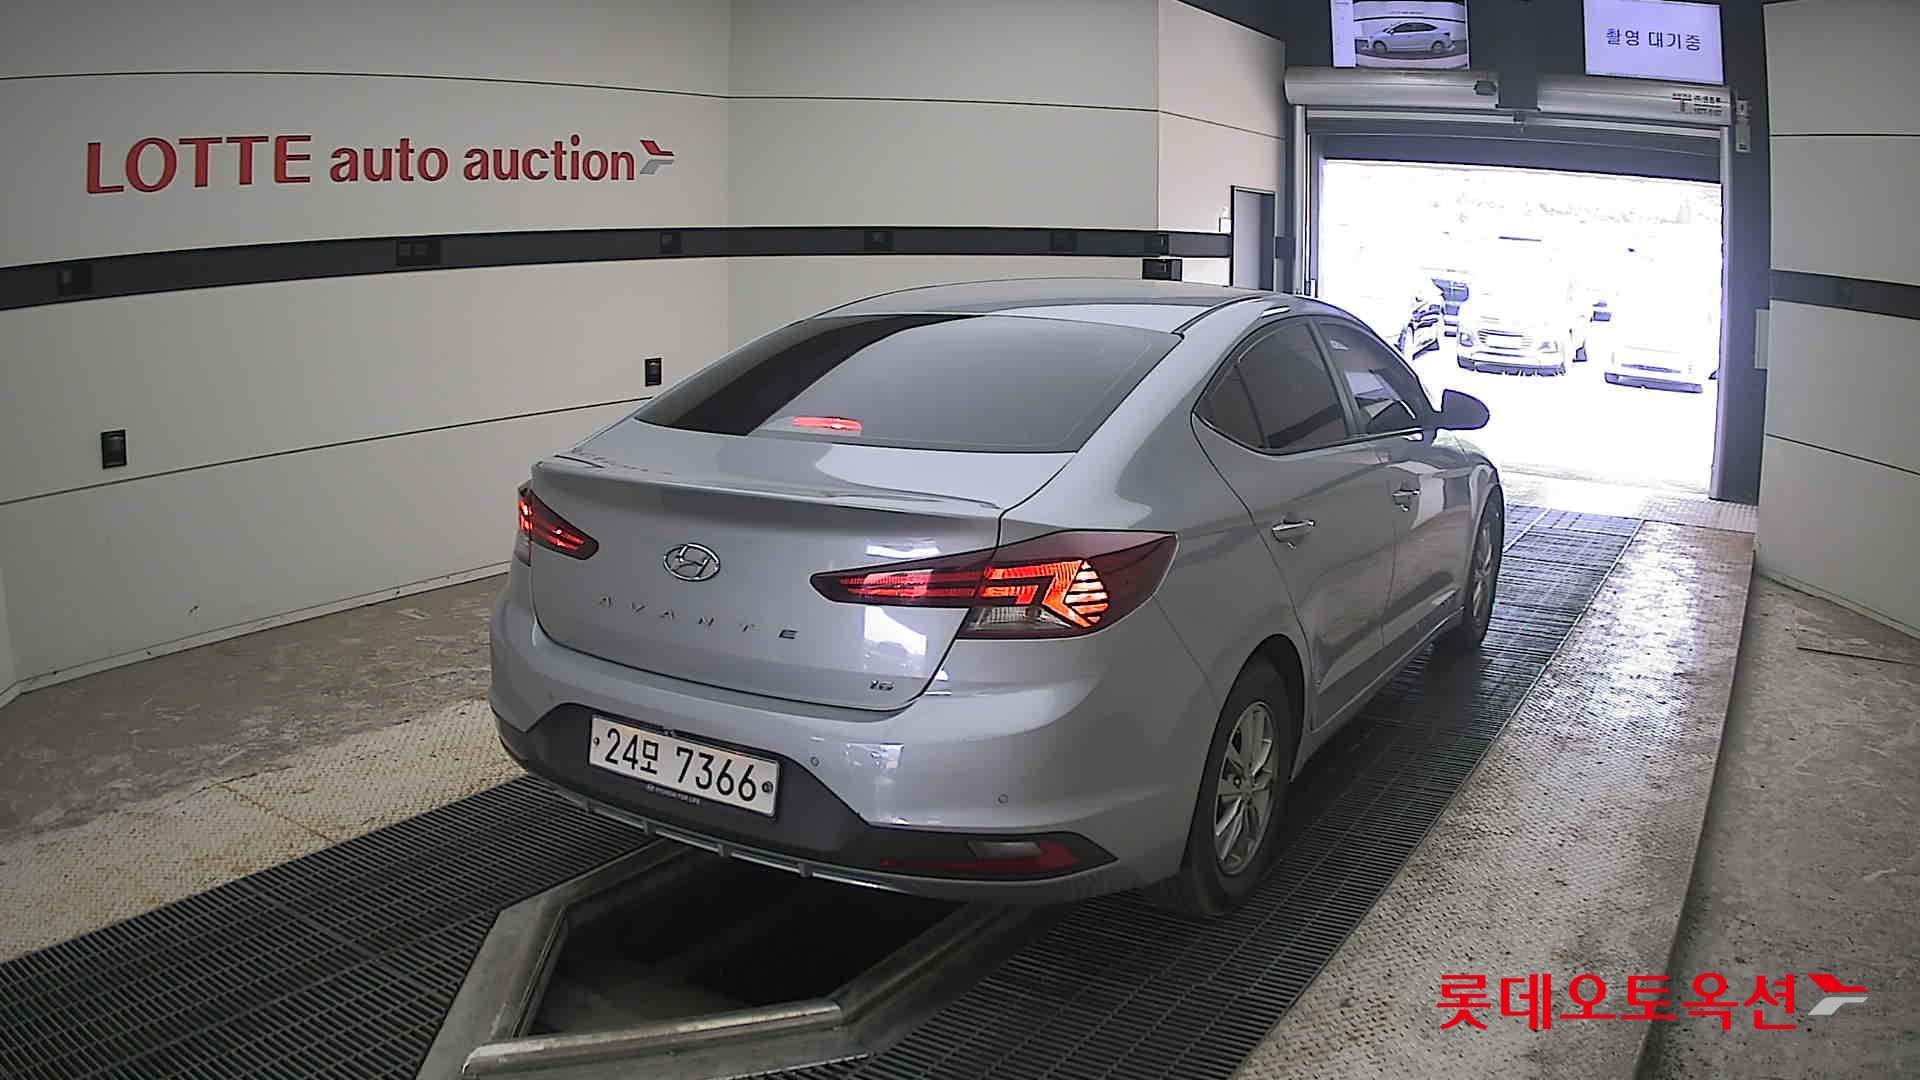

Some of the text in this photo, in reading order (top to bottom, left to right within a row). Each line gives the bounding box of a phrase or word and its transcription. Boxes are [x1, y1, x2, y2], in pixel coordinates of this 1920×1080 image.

[1607, 28, 1701, 51] 촬영 대기중
[87, 134, 635, 194] LOTTE auto auction
[600, 597, 798, 639] AVANTE
[604, 728, 659, 774] 24모
[675, 748, 758, 802] 7366
